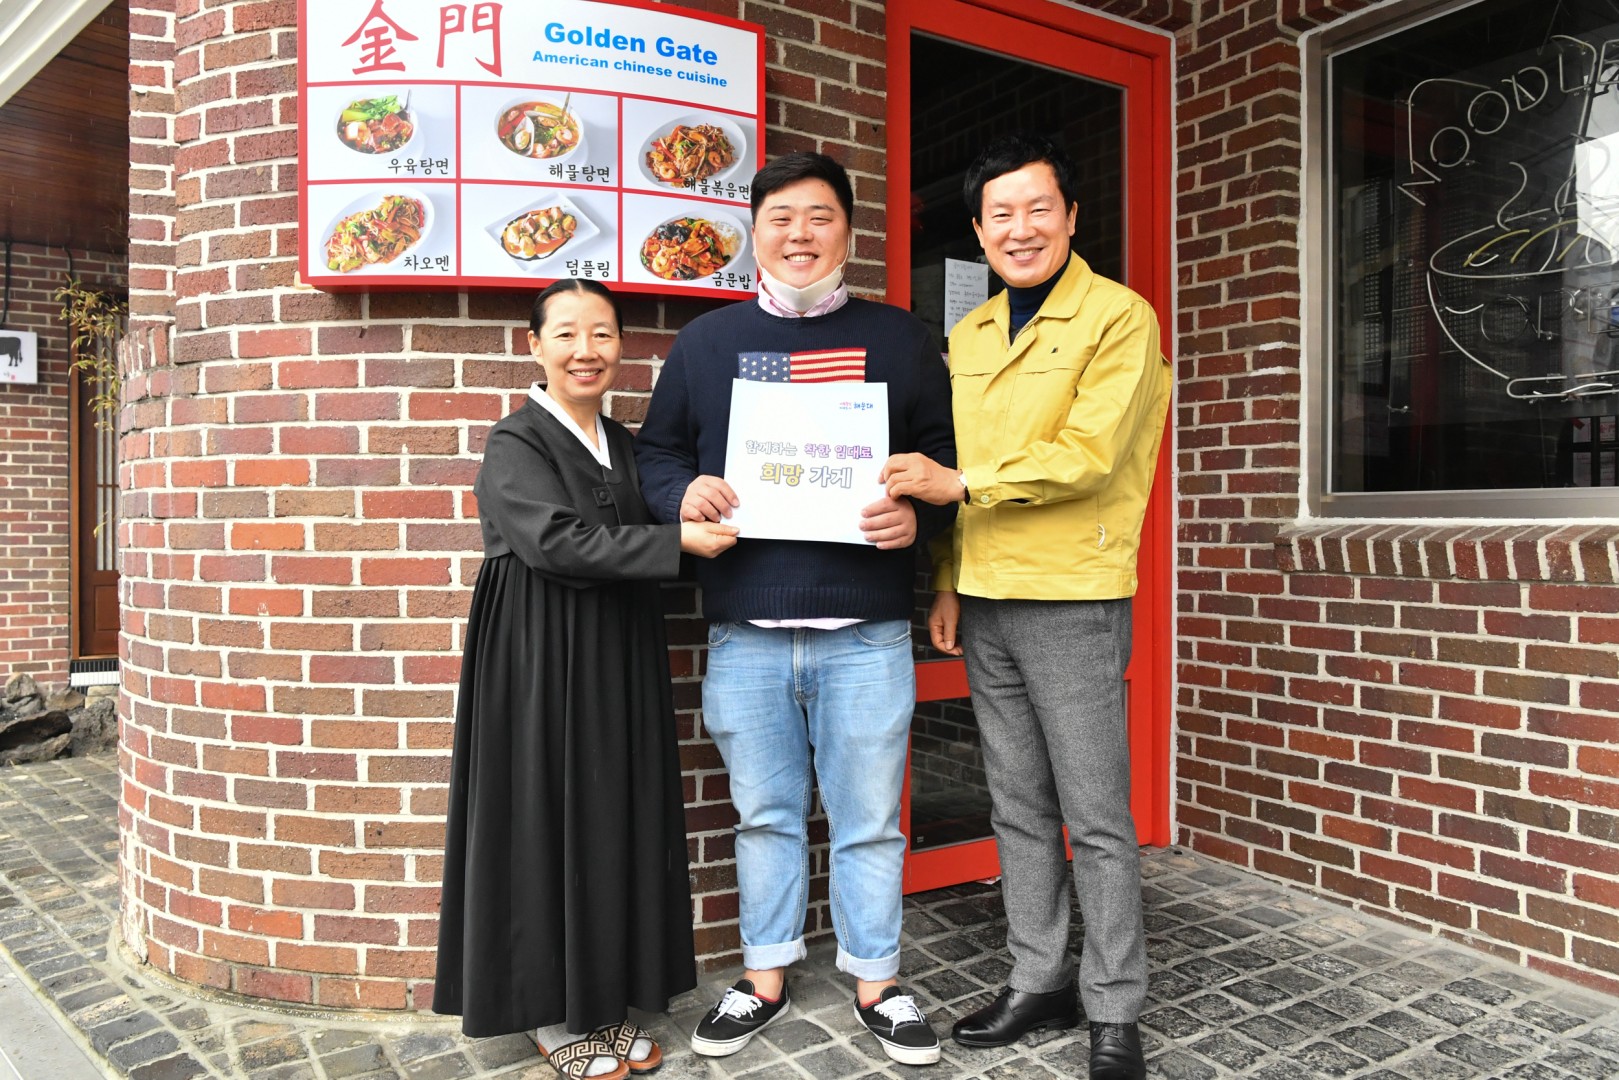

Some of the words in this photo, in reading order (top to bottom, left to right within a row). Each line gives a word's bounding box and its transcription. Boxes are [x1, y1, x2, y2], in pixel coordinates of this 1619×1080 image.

[341, 0, 503, 77] 金門
[544, 22, 645, 53] Golden
[656, 36, 718, 65] Gate
[532, 50, 609, 68] American
[613, 60, 673, 77] chinese
[677, 70, 727, 87] cuisine
[387, 158, 449, 175] 우육탕면
[549, 163, 610, 183] 해물탕면
[684, 176, 750, 200] 해물볶음면
[404, 254, 449, 272] 차오멘
[565, 258, 610, 278] 덤플링
[712, 272, 751, 290] 금문밥
[746, 440, 797, 456] 함께하는
[804, 443, 831, 458] 착한
[834, 445, 873, 460] 임대료
[760, 463, 804, 486] 희망
[809, 466, 853, 489] 가게
